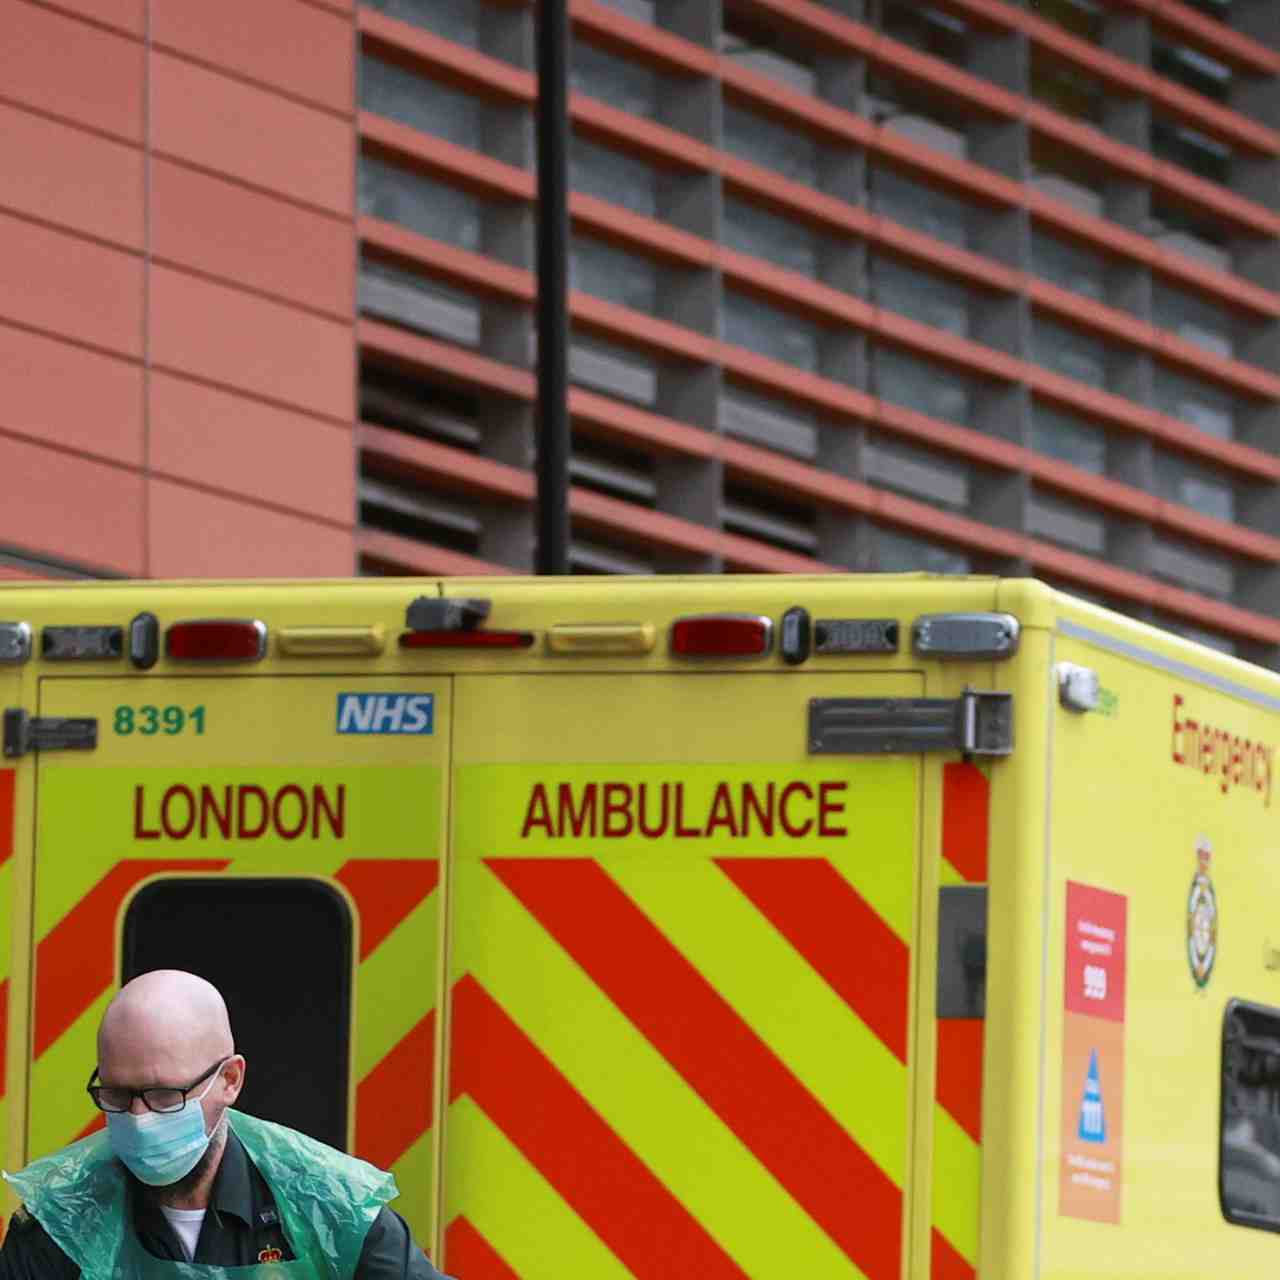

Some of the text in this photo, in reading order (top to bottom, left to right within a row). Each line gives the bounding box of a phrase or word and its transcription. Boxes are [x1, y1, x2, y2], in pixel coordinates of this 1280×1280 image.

[113, 704, 206, 736] 8391
[339, 696, 428, 731] NHS
[1172, 693, 1272, 806] Emergency
[133, 781, 849, 840] LONDON AMBULANCE
